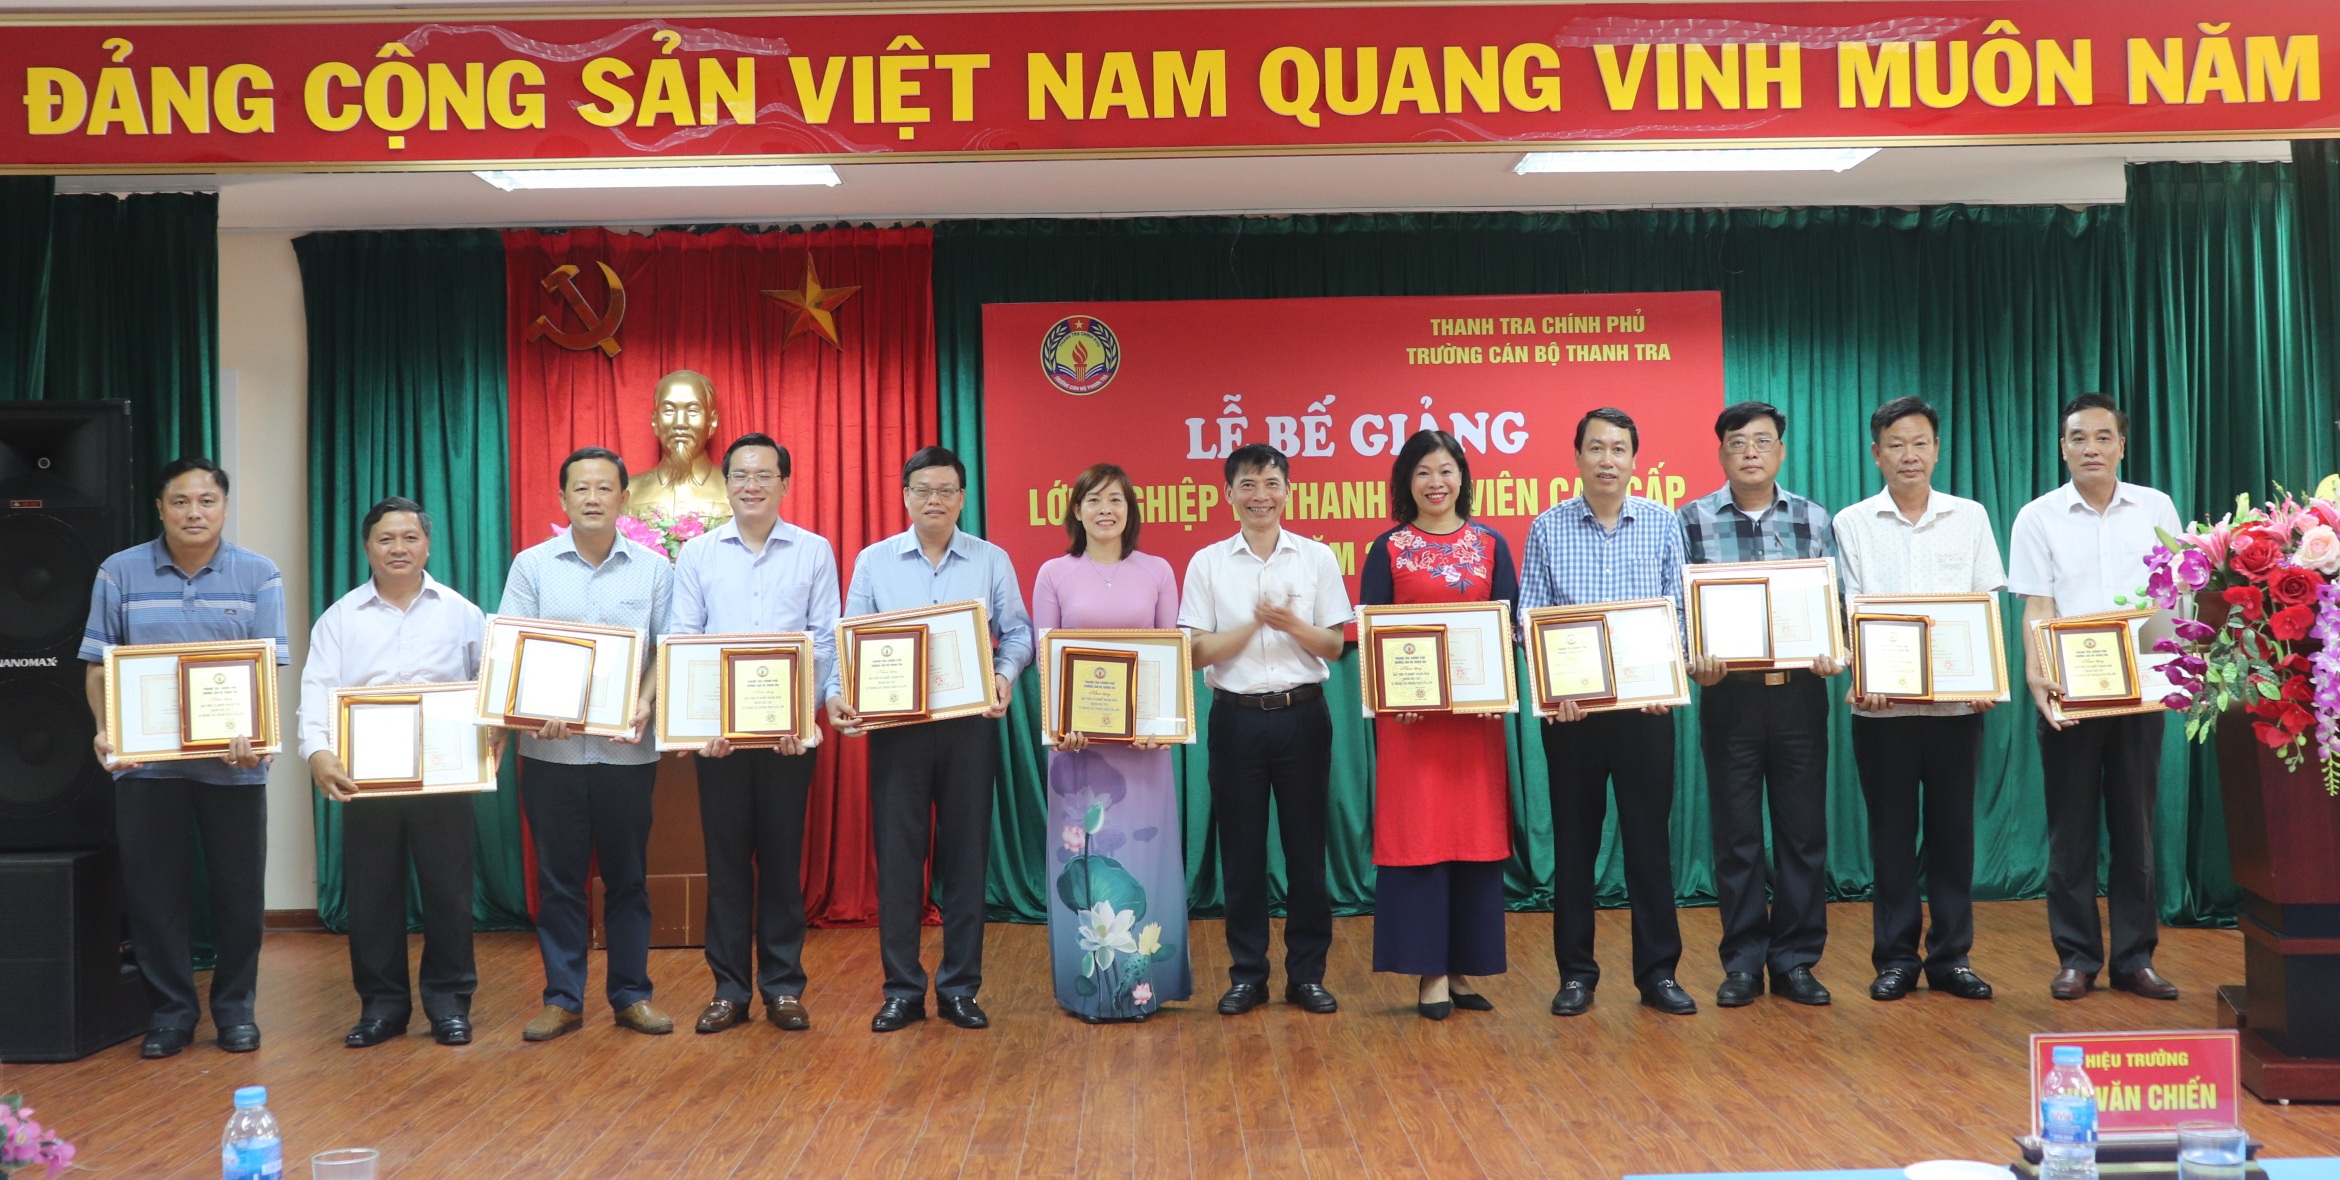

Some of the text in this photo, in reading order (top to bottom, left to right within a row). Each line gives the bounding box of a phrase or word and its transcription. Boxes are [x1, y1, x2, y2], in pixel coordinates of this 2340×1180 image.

[23, 20, 2322, 149] ĐẢNG CỘNG SẢN VIỆT NAM QUANG VINH MUÔN NĂM
[1430, 308, 1645, 336] THANH TRA CHÍNH PHỦ
[1406, 342, 1671, 366] TRƯỜNG CÁN BỘ THANH TRA
[1185, 394, 1248, 460] LỄ
[1265, 394, 1336, 458] BẾ
[1029, 480, 1073, 526] LỚ
[1133, 477, 1219, 531] HIỆP
[1285, 481, 1387, 520] THANH
[1471, 471, 1539, 517] VIÊN
[2085, 1048, 2189, 1071] HIỆU TRƯỞNG
[2095, 1075, 2217, 1112] VĂN CHIẾN
